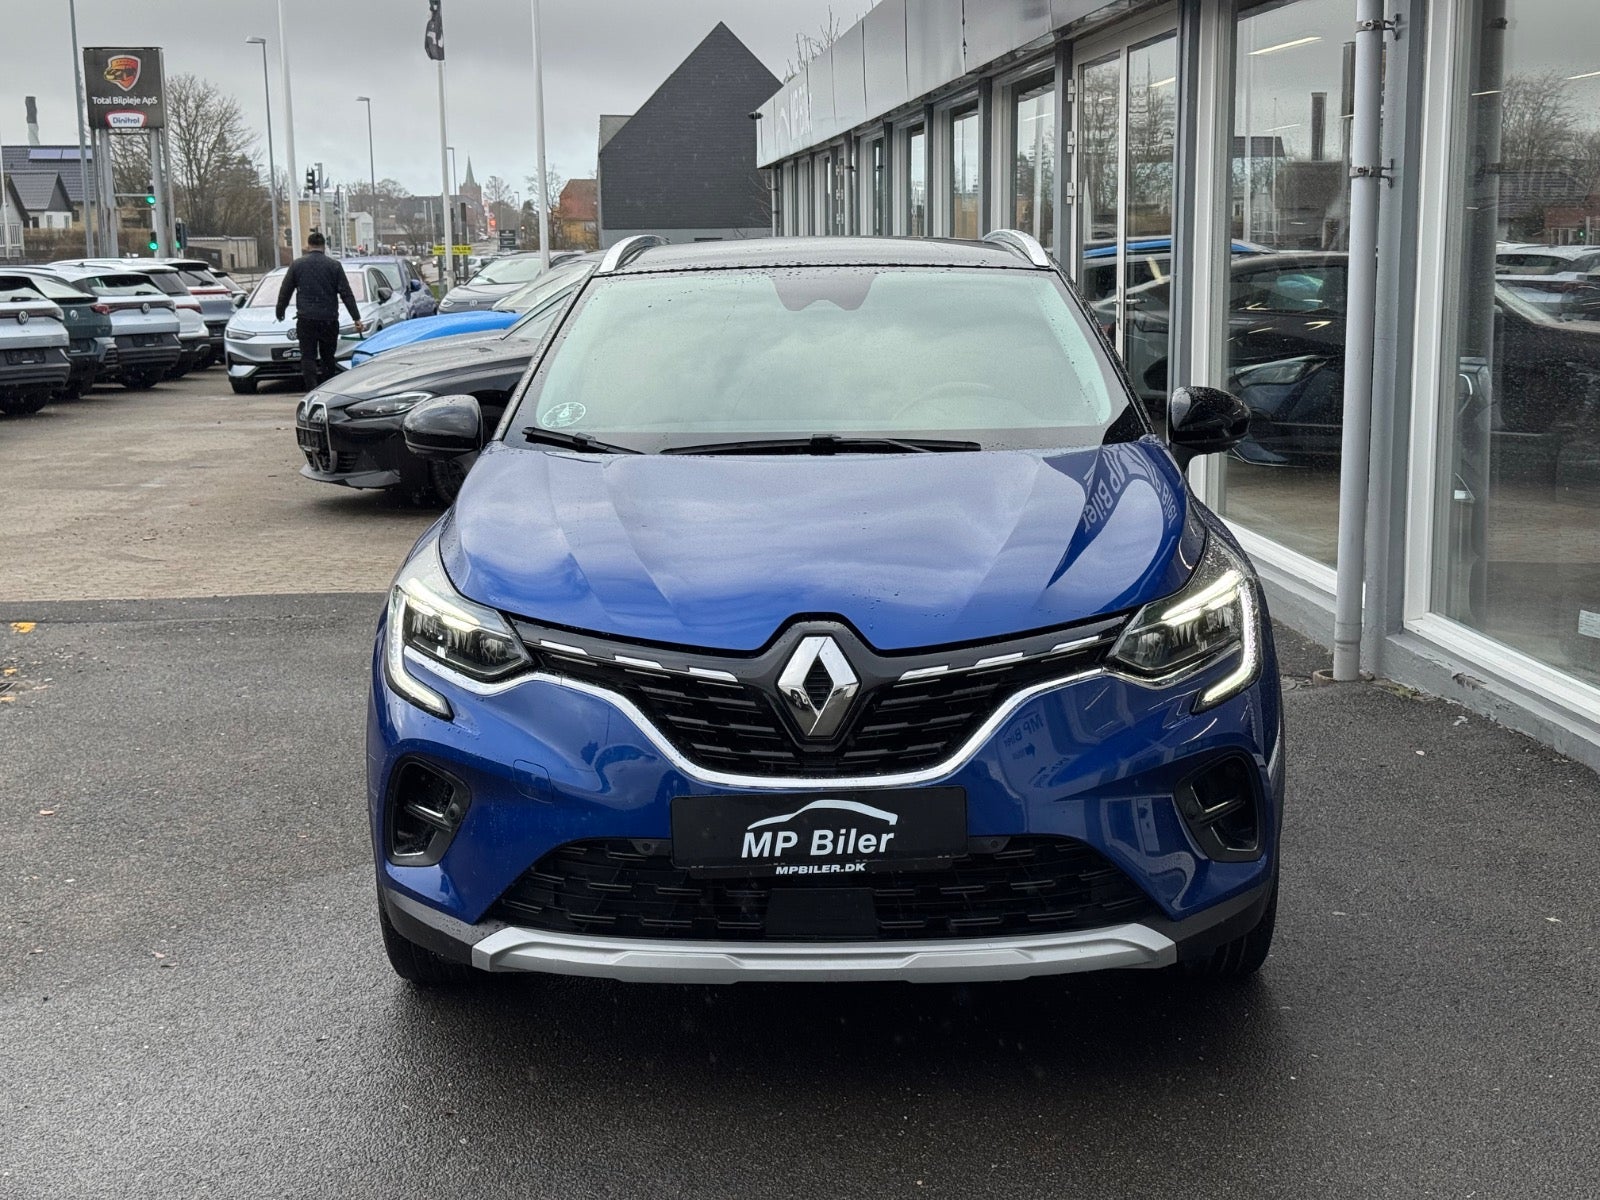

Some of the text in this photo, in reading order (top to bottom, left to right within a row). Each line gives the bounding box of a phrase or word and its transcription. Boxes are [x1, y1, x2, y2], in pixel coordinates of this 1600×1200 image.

[92, 96, 158, 106] Total Bilpleje ApS
[741, 828, 895, 858] MP Biler
[775, 863, 866, 875] MPBILER.DK
